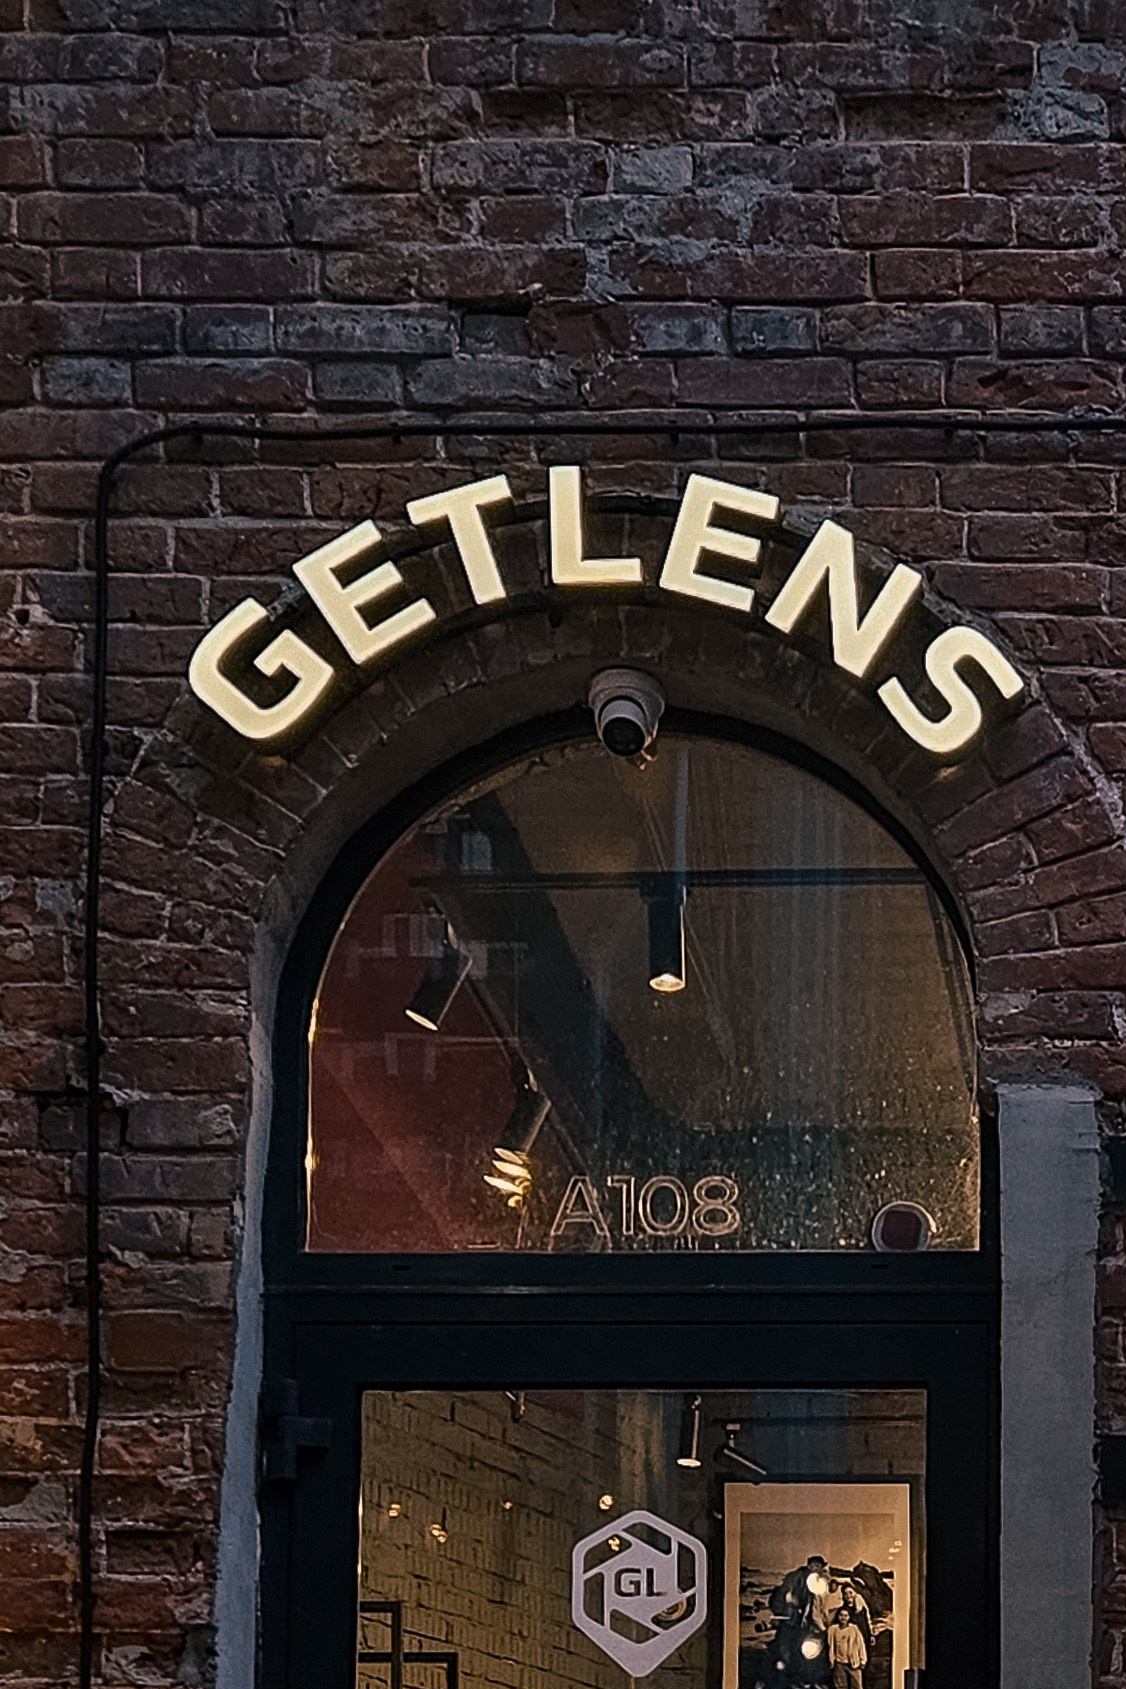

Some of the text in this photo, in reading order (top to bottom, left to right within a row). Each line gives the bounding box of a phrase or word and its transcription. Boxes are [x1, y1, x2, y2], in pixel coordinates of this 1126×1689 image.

[188, 465, 1024, 754] GETLENS
[549, 1175, 741, 1237] A108
[614, 1567, 669, 1598] GL
